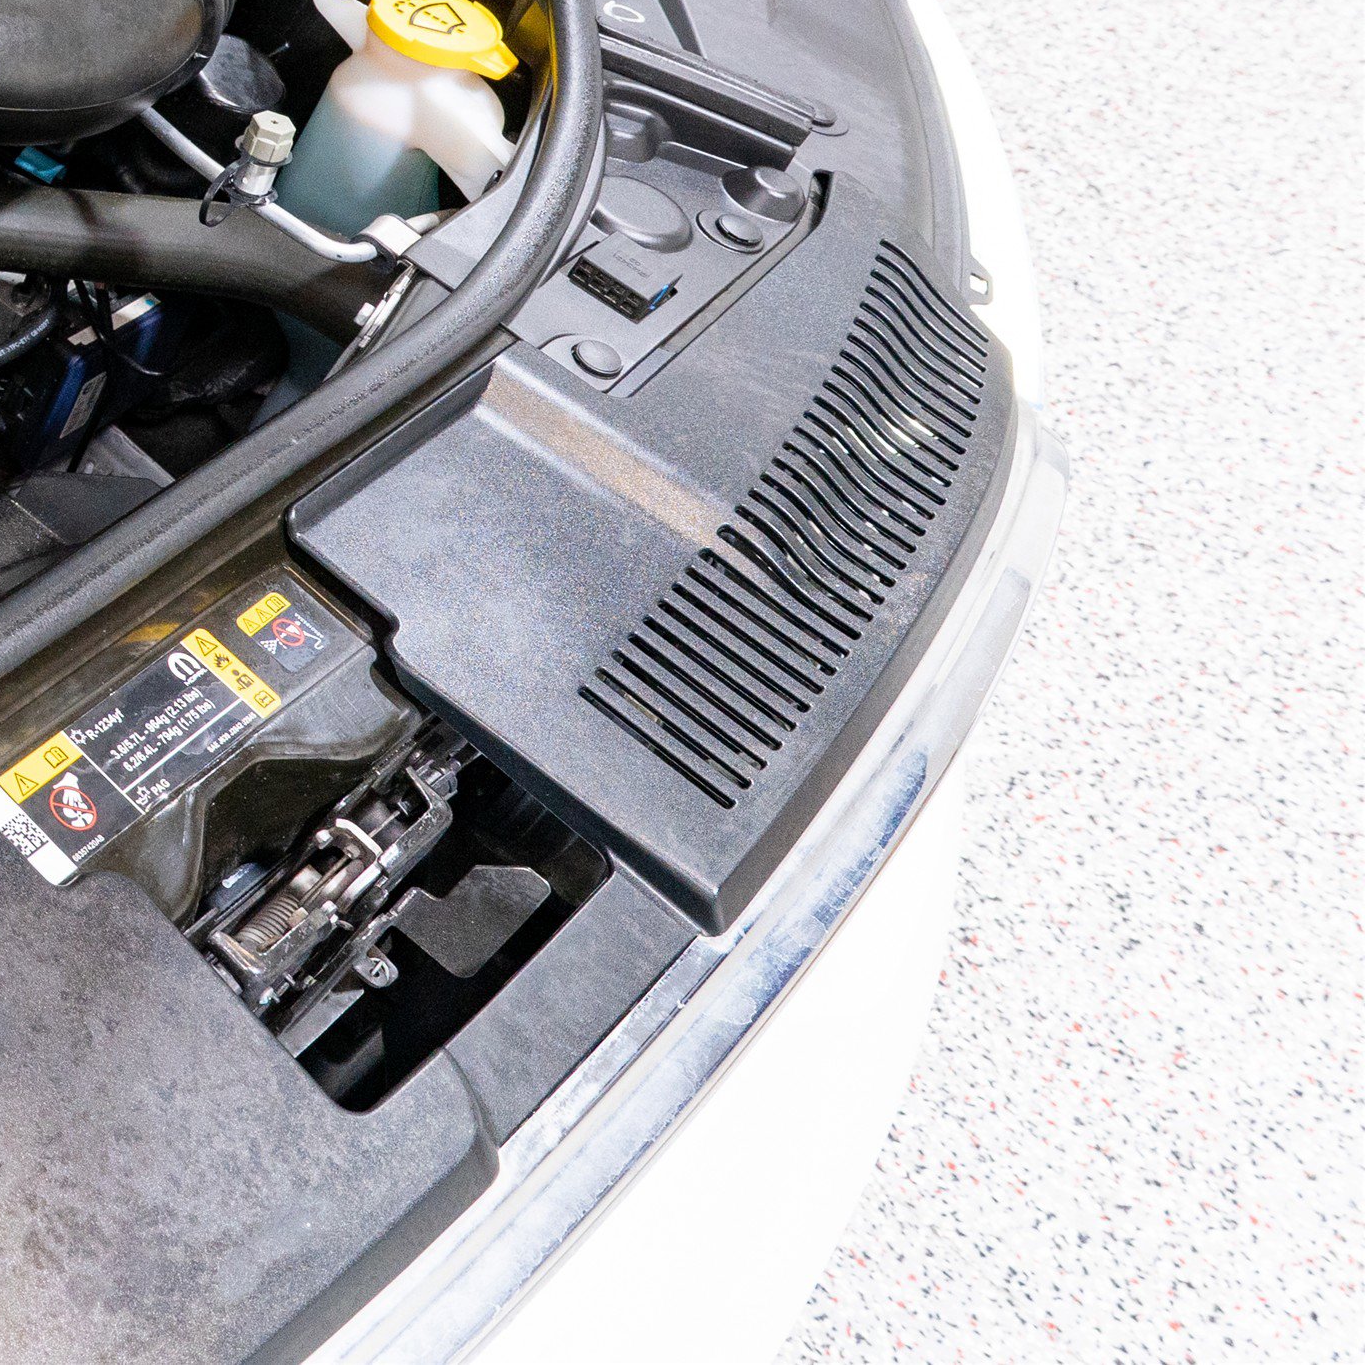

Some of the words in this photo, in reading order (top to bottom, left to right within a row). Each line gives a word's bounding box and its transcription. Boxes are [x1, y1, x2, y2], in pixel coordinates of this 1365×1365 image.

[84, 707, 126, 742] R-1234yf
[109, 730, 146, 760] 3.6/5.7L
[164, 697, 188, 719] (2.13
[182, 686, 204, 704] lbs)
[122, 742, 159, 772] 6.2/6.4L
[156, 725, 184, 745] 794g
[176, 708, 201, 731] (1.75
[194, 698, 217, 715] lbs)
[150, 778, 171, 796] PAG
